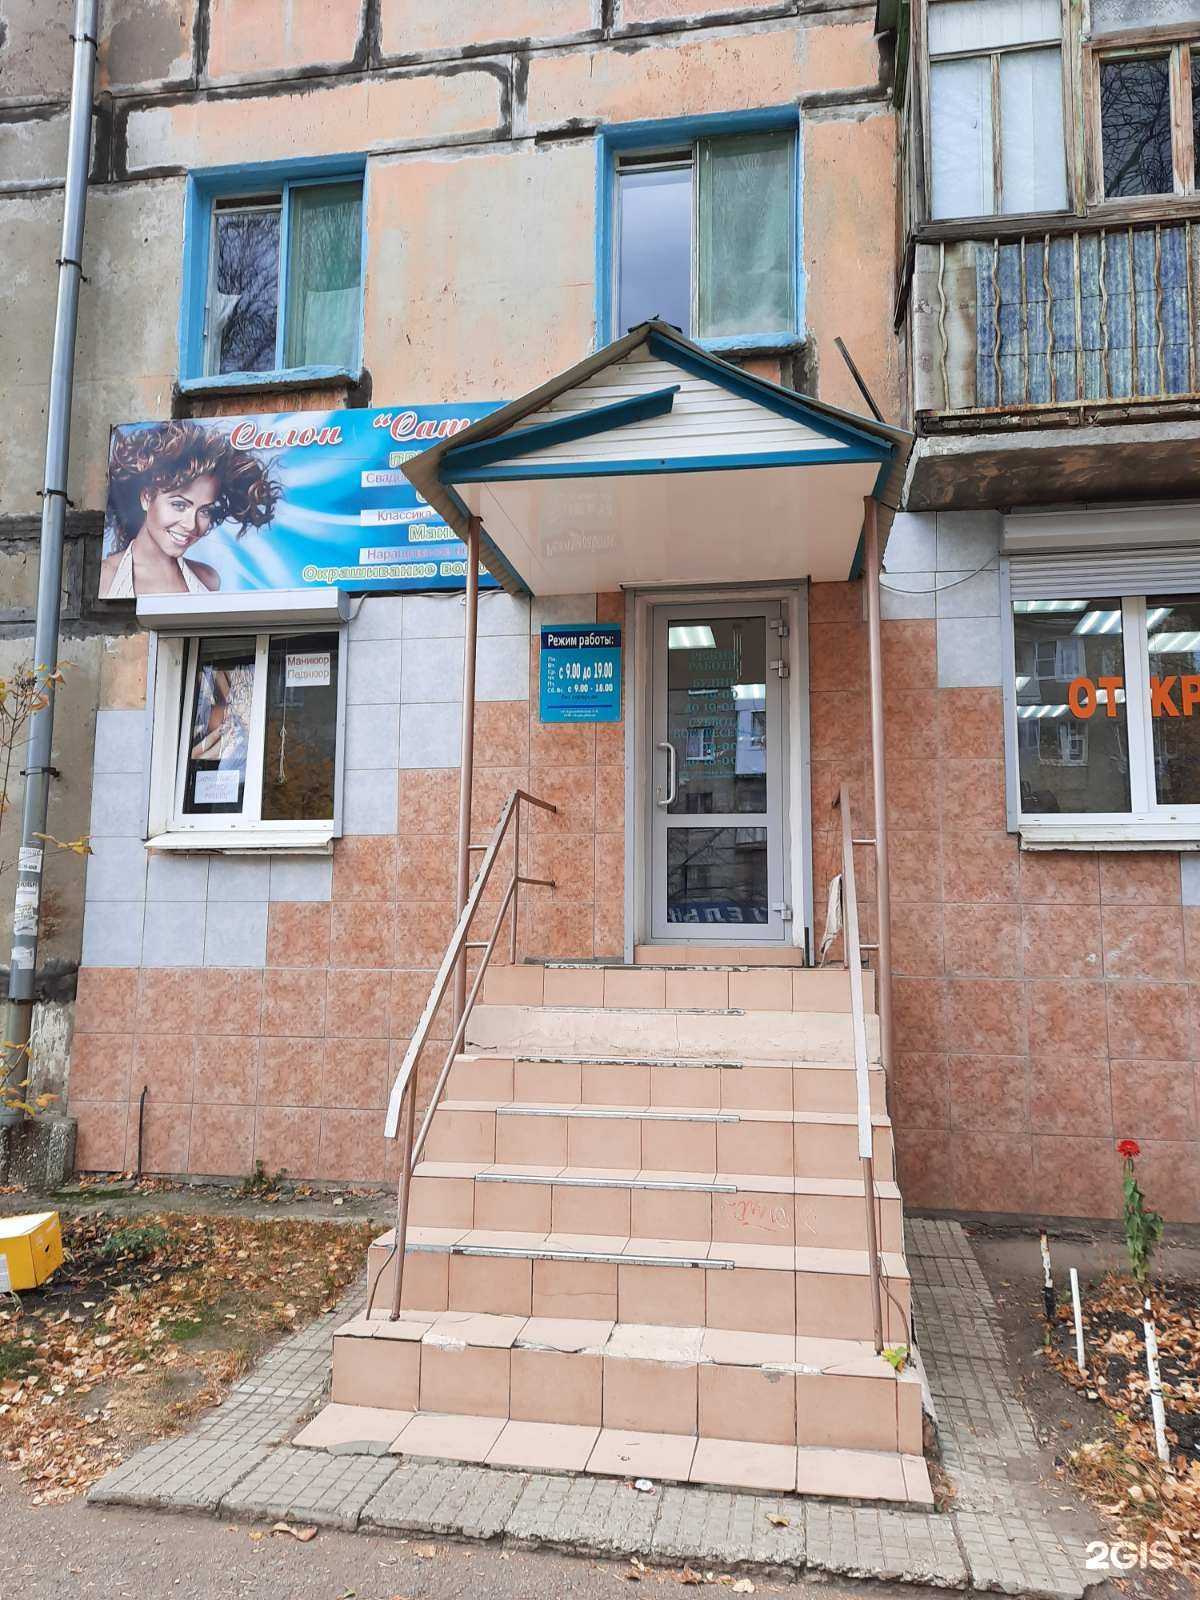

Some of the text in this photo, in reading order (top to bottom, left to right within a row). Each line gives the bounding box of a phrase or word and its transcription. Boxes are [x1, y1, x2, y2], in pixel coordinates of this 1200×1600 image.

[230, 411, 472, 450] Салон “Сат
[302, 563, 437, 584] Окрашивание
[547, 632, 614, 648] Режим работы:
[287, 656, 330, 667] Маникюр
[565, 662, 581, 680] 9.00
[583, 667, 591, 680] до
[594, 661, 613, 679] 19.00
